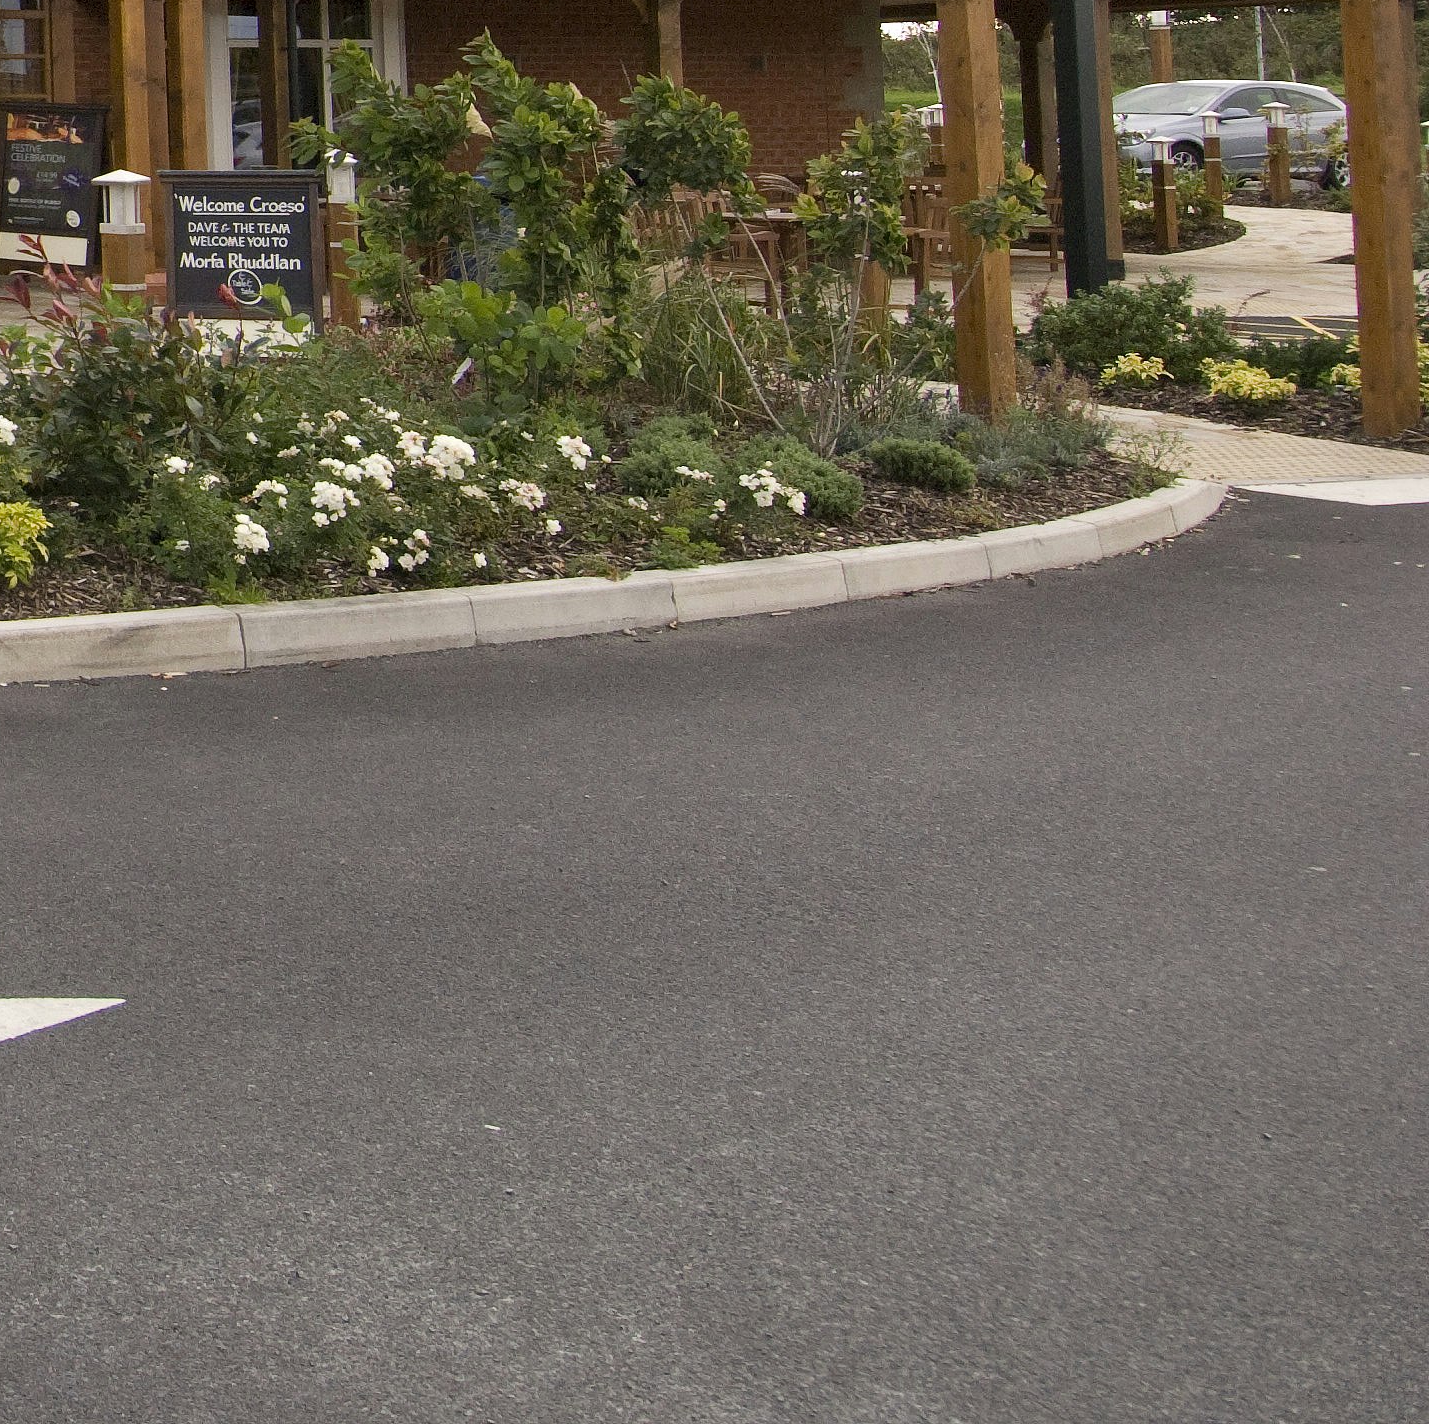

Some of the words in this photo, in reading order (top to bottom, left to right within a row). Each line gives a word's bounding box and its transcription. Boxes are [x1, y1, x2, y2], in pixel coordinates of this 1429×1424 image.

[11, 143, 42, 153] FESTIVE
[11, 153, 66, 163] CELEBRATION
[188, 222, 219, 233] DAVE
[221, 222, 230, 233] &
[233, 223, 255, 234] THE
[257, 223, 291, 234] TEAM
[189, 236, 246, 247] WELCOME
[247, 237, 270, 247] YOU
[271, 237, 288, 248] TO
[180, 252, 225, 269] Morfa
[228, 253, 301, 270] Rhuddlan
